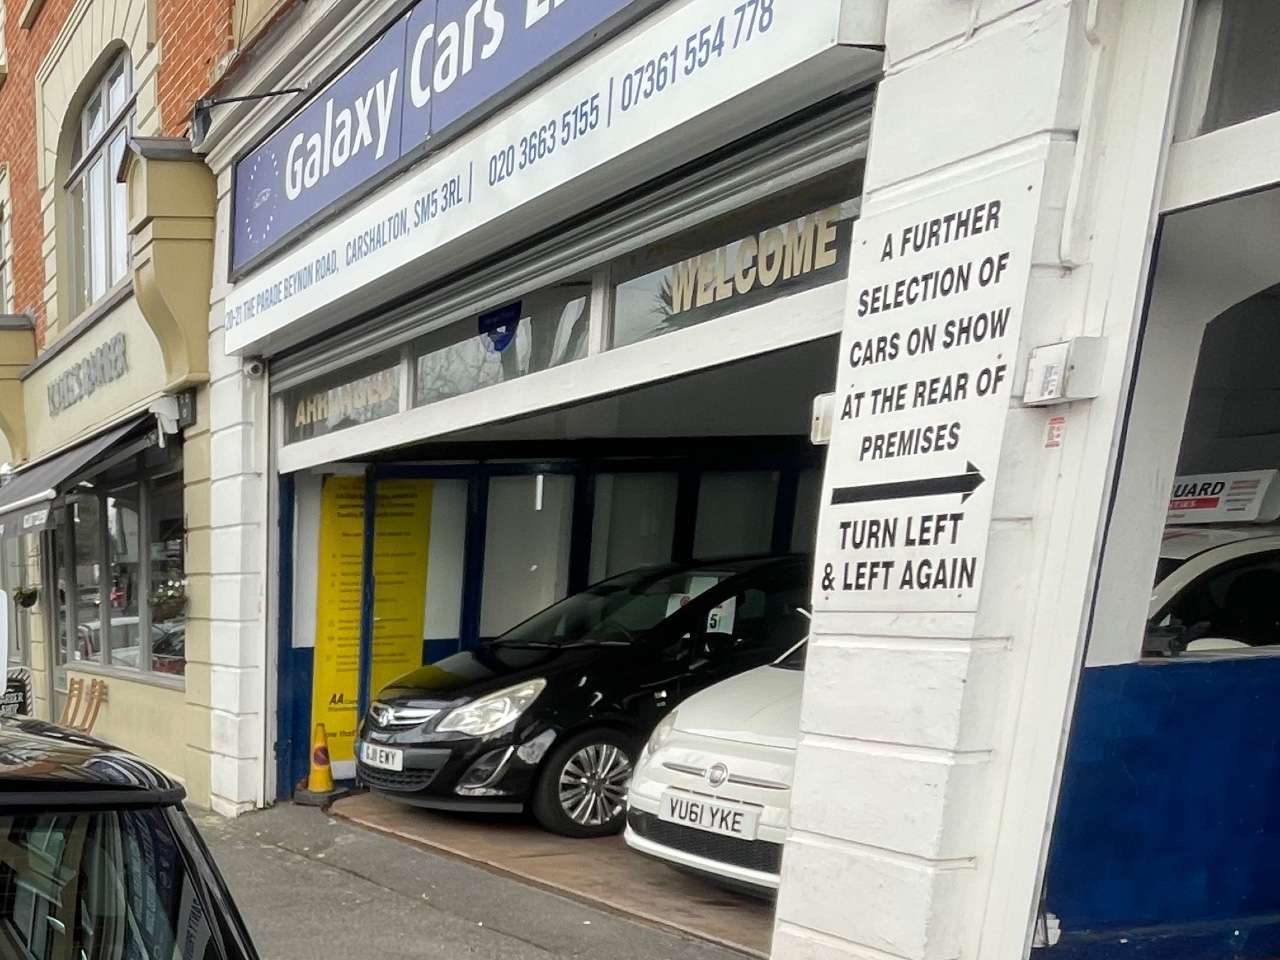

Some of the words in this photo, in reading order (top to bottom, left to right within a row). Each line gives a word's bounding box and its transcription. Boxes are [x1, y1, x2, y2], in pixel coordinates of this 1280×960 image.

[285, 68, 399, 200] Galaxy
[410, 0, 504, 108] Cars
[243, 296, 256, 321] THE
[256, 280, 283, 314] PARADE
[284, 262, 314, 300] BEYNON
[414, 188, 438, 229] SM5
[441, 174, 463, 213] 3RL
[488, 144, 514, 187] 020
[519, 119, 556, 170] 3663
[561, 93, 599, 146] 5155
[621, 45, 678, 112] 07361
[684, 16, 726, 76] 554
[733, 0, 775, 49] 778
[671, 205, 841, 315] WELCOME
[880, 233, 893, 262] A
[900, 200, 1001, 257] FURTHER
[857, 262, 972, 317] SELECTION
[978, 251, 1010, 287] OF
[849, 332, 901, 369] CARS
[907, 323, 937, 356] ON
[942, 306, 1012, 349] SHOW
[840, 391, 866, 421] AT
[870, 383, 909, 415] THE
[912, 372, 970, 409] REAR
[976, 364, 1007, 397] OF
[859, 422, 962, 462] PREMISES
[839, 516, 899, 550] TURN
[904, 512, 965, 547] LEFT
[821, 562, 836, 591] &
[842, 560, 896, 591] LEFT
[899, 556, 978, 590] AGAIN
[670, 798, 705, 825] VU61
[710, 806, 746, 833] YKE
